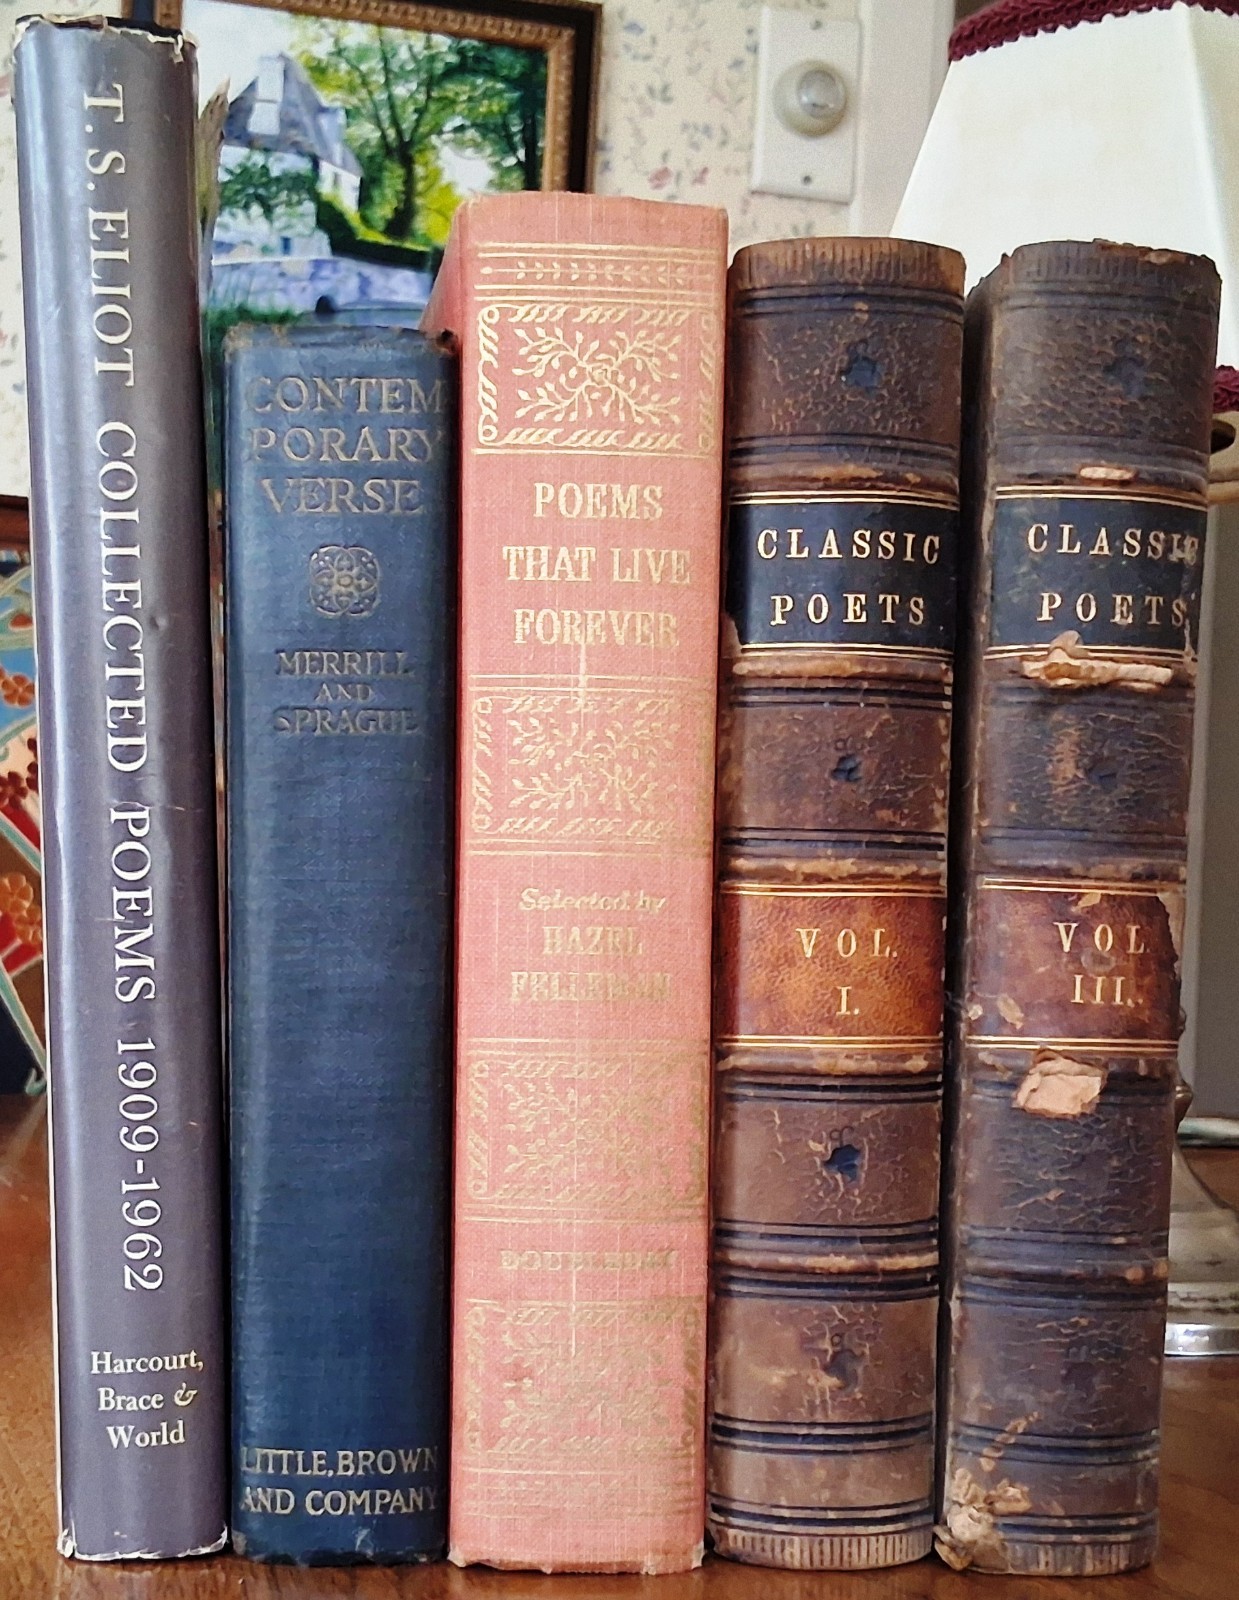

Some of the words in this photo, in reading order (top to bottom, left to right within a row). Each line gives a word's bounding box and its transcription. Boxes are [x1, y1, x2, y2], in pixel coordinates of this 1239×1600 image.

[83, 82, 125, 133] T.
[85, 149, 127, 191] S.
[88, 207, 135, 387] ELIOT
[248, 425, 444, 463] PORARY
[260, 478, 424, 514] VERSE
[533, 482, 663, 520] POEMS
[502, 545, 597, 582] THAT
[610, 547, 691, 584] LIVE
[756, 527, 940, 565] CLASSIC
[97, 421, 150, 773] COLLECTED
[770, 593, 925, 627] POETS
[1036, 591, 1187, 628] POETS
[513, 608, 680, 647] FOREVER
[275, 649, 415, 677] MERRILL
[316, 682, 374, 704] AND
[272, 706, 421, 736] SPRAGUE
[111, 804, 156, 1002] POEMS
[796, 928, 899, 958] VOL.
[836, 986, 860, 1017] I.
[117, 1039, 164, 1291] 1909-1962
[90, 1350, 205, 1376] Harcourt,
[98, 1385, 165, 1411] Brace
[173, 1383, 198, 1409] &
[107, 1421, 186, 1449] World
[240, 1486, 296, 1515] AND
[304, 1486, 437, 1517] COMPANY
